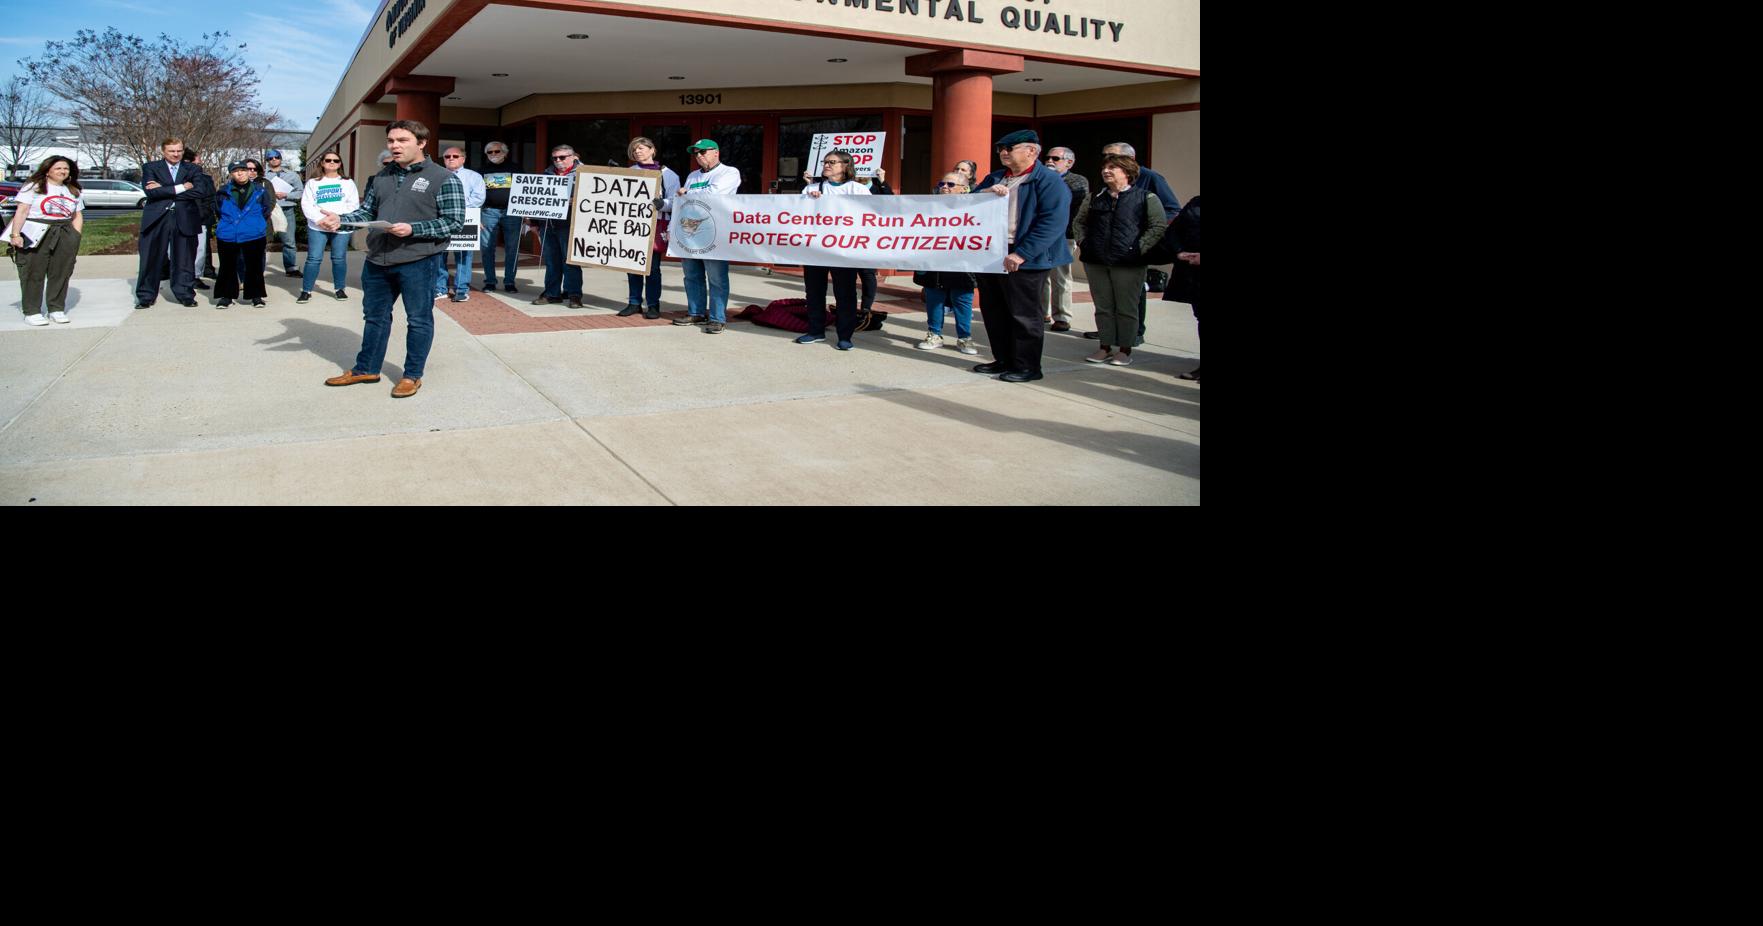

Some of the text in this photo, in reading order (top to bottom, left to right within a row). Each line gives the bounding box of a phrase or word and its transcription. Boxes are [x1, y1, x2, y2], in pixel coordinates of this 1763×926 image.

[1000, 6, 1124, 43] QUALITY
[679, 93, 722, 105] 13901
[833, 135, 877, 146] STOP
[853, 154, 873, 165] OP
[515, 175, 544, 185] SAVE
[546, 177, 569, 186] THE
[591, 176, 650, 199] DATA
[522, 186, 558, 196] RURAL
[510, 196, 568, 207] CRESCENT
[579, 198, 654, 218] CENTERS
[511, 208, 563, 218] ProtectPWC.org
[732, 211, 981, 228] Data Centers Run Amok.
[588, 218, 651, 237] ARE BAD
[728, 231, 993, 251] PROTECT OUR CITIZENS!
[573, 237, 647, 266] Neighbors
